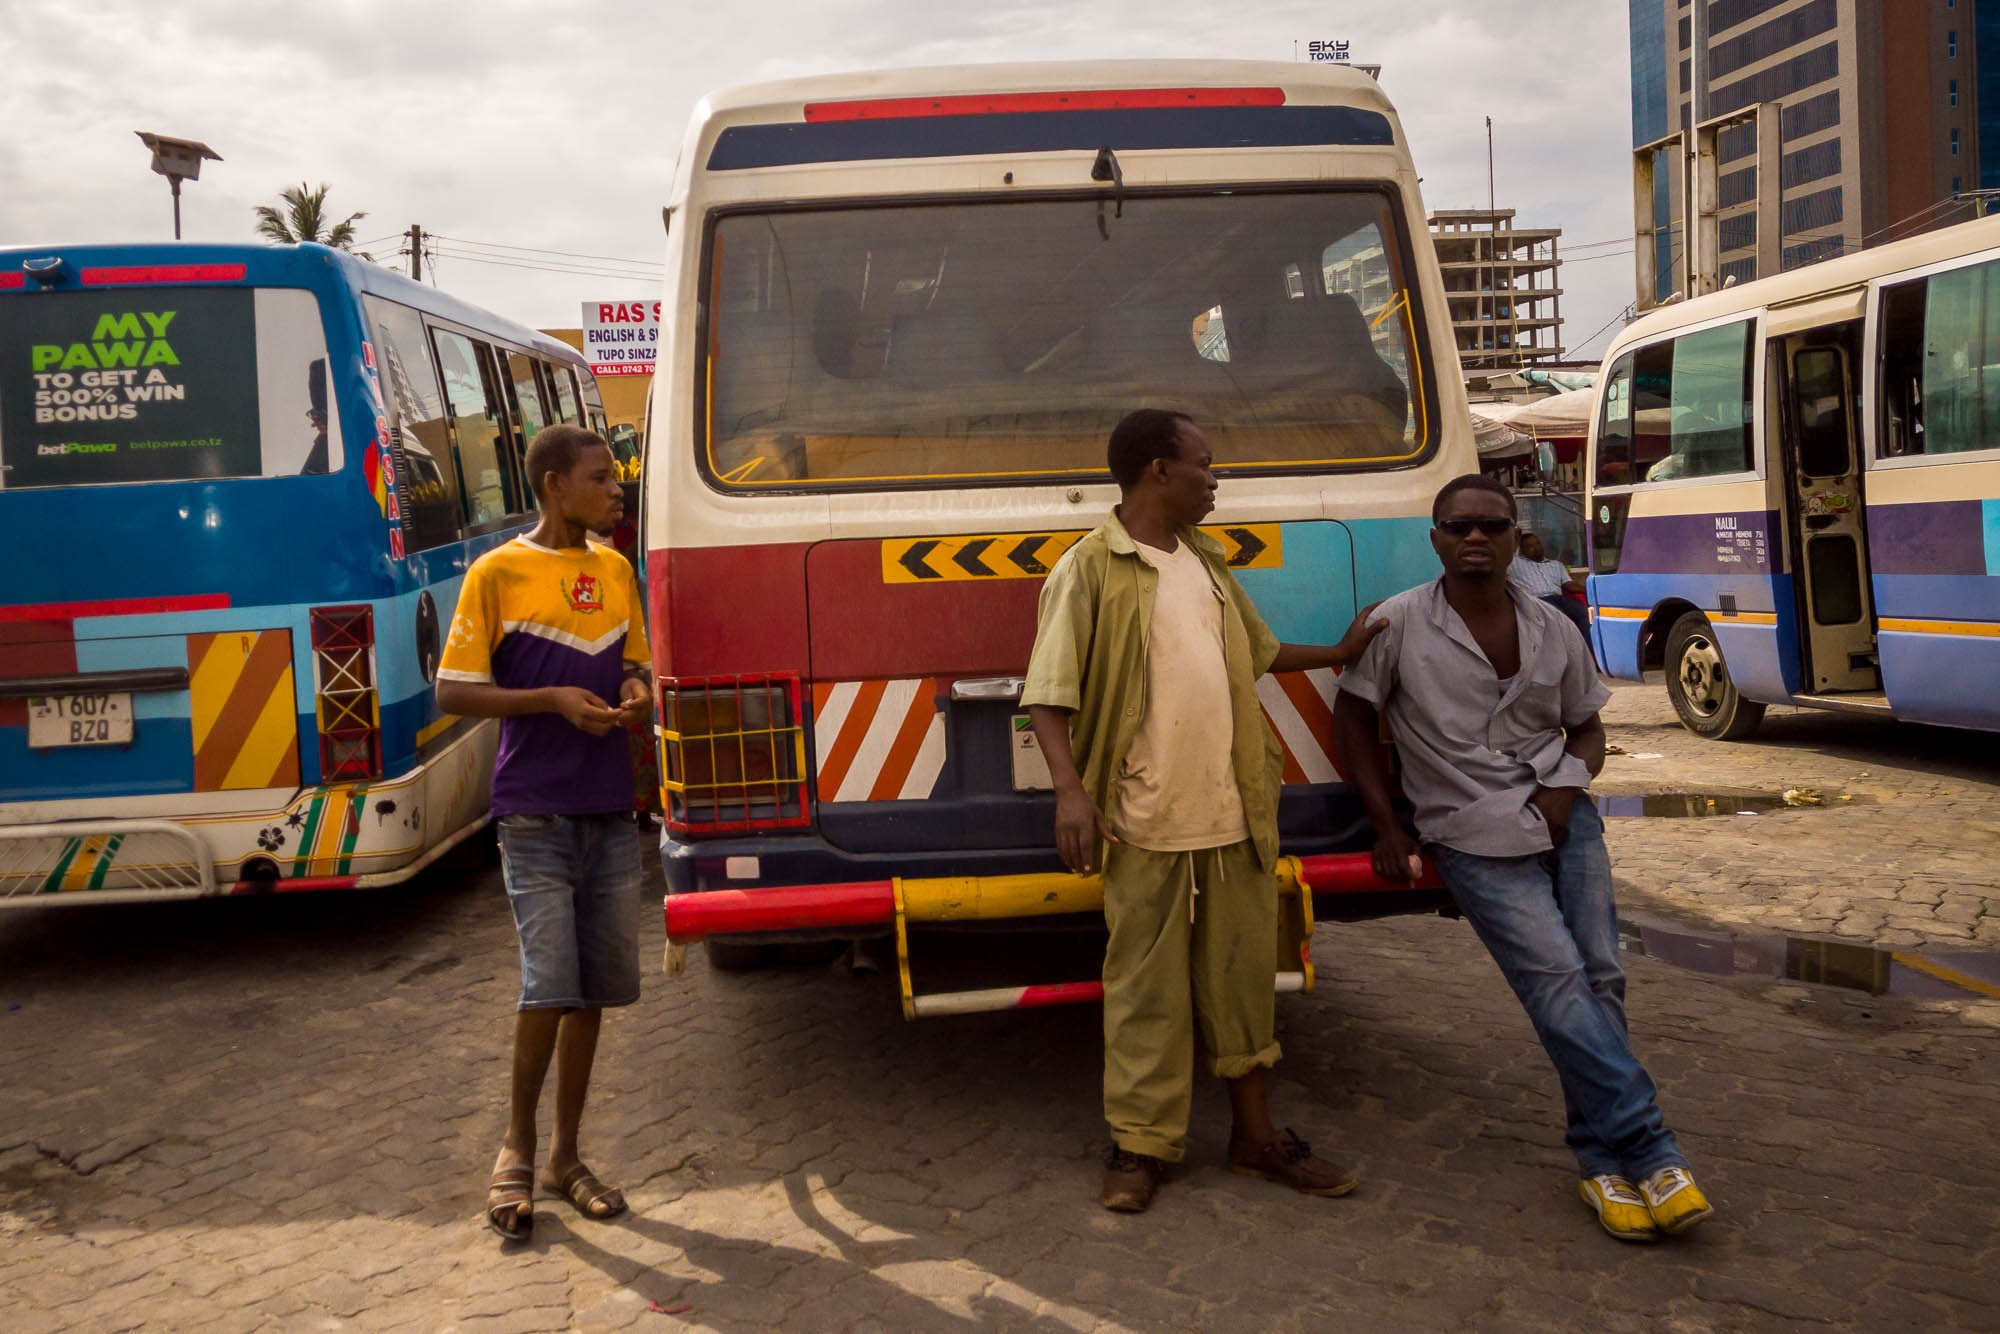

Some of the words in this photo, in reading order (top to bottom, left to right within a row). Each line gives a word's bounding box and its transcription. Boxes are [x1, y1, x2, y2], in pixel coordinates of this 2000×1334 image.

[1309, 40, 1349, 52] SKY
[1309, 52, 1350, 60] TOWER
[599, 303, 645, 323] RAS
[92, 310, 177, 340] MY
[588, 329, 635, 343] ENGLISH
[638, 328, 646, 341] &
[32, 339, 181, 371] PAWA
[597, 349, 625, 360] TUPO
[33, 372, 74, 390] TO
[80, 369, 138, 387] GET
[145, 368, 168, 385] A
[596, 365, 620, 374] CALL:
[622, 365, 643, 374] 0742
[35, 387, 117, 406] 500%
[124, 384, 185, 401] WIN
[35, 403, 138, 424] BONUS
[37, 442, 117, 455] betPawa
[129, 437, 223, 450] betpawa.co.tz
[362, 341, 405, 560] NISSAN
[1715, 517, 1737, 530] NAULI
[53, 694, 65, 717] T
[70, 693, 109, 716] 607
[70, 719, 109, 742] BZQ
